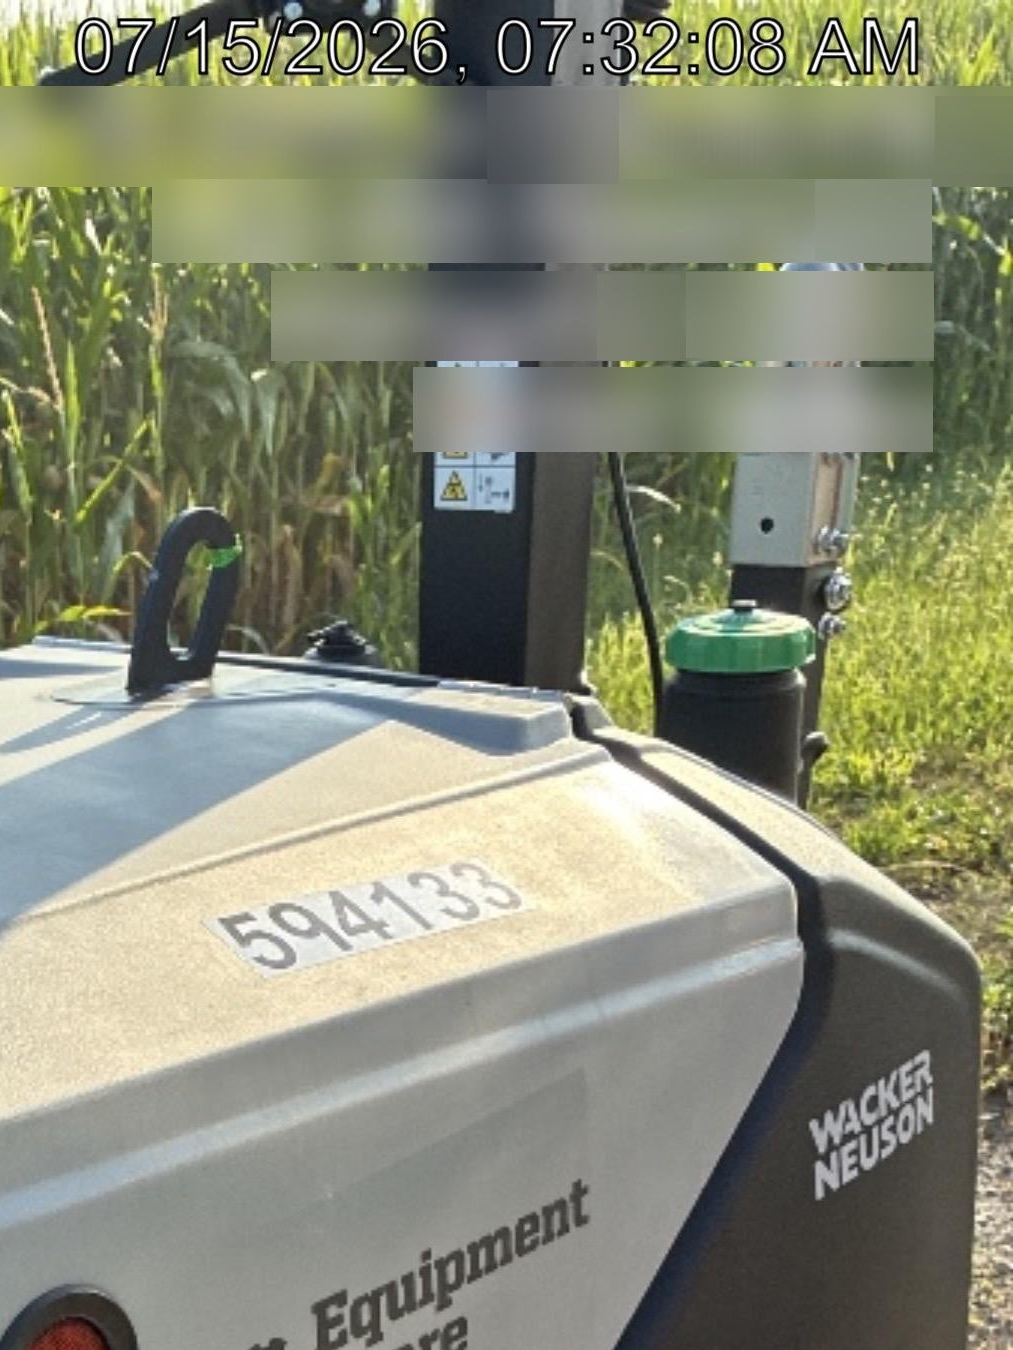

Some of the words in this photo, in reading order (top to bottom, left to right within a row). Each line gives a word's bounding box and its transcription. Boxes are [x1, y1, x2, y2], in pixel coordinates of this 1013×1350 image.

[218, 861, 522, 970] 594133
[809, 1050, 934, 1155] WACKER
[814, 1087, 934, 1201] NEUSON
